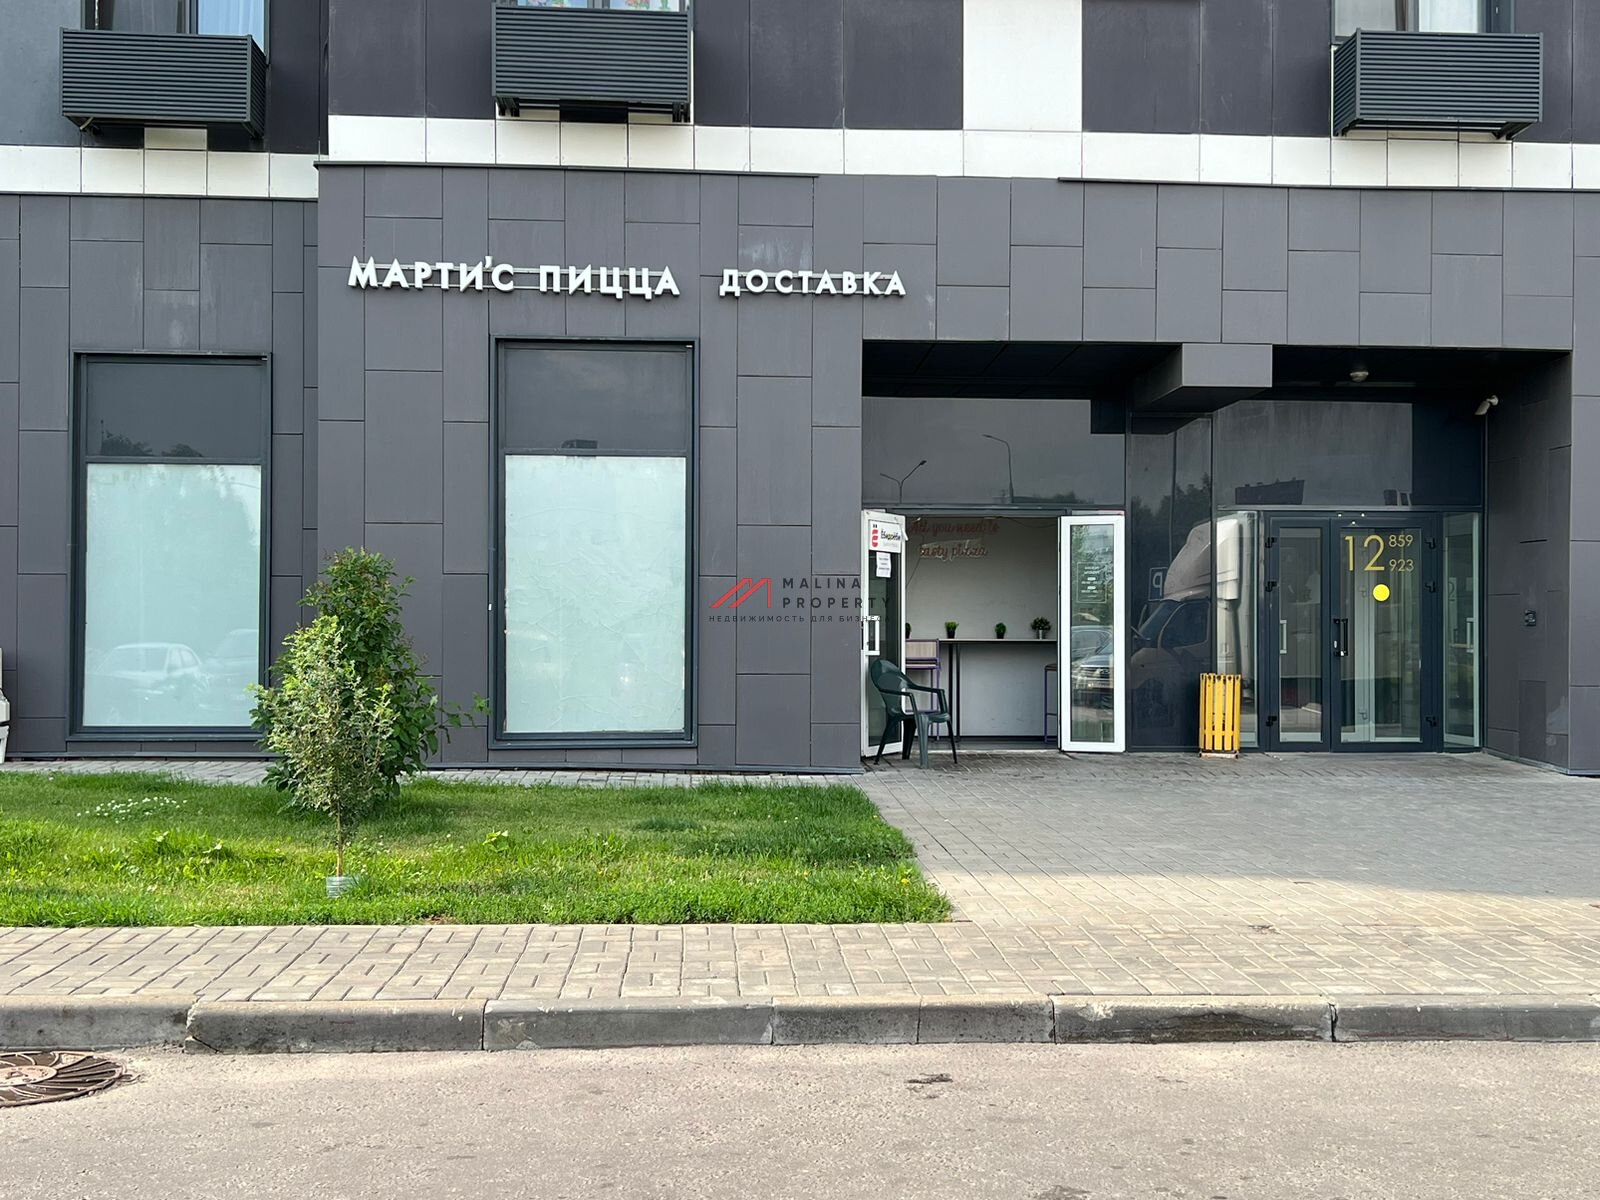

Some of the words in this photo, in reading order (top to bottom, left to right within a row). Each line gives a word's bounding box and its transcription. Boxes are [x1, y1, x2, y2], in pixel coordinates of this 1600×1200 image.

[348, 255, 514, 293] МАРТИ'С
[539, 264, 680, 299] ПИЦЦА
[719, 269, 906, 297] ДОСТАВКА
[1344, 534, 1385, 571] 12
[1388, 534, 1414, 548] 859
[1388, 558, 1414, 572] 923
